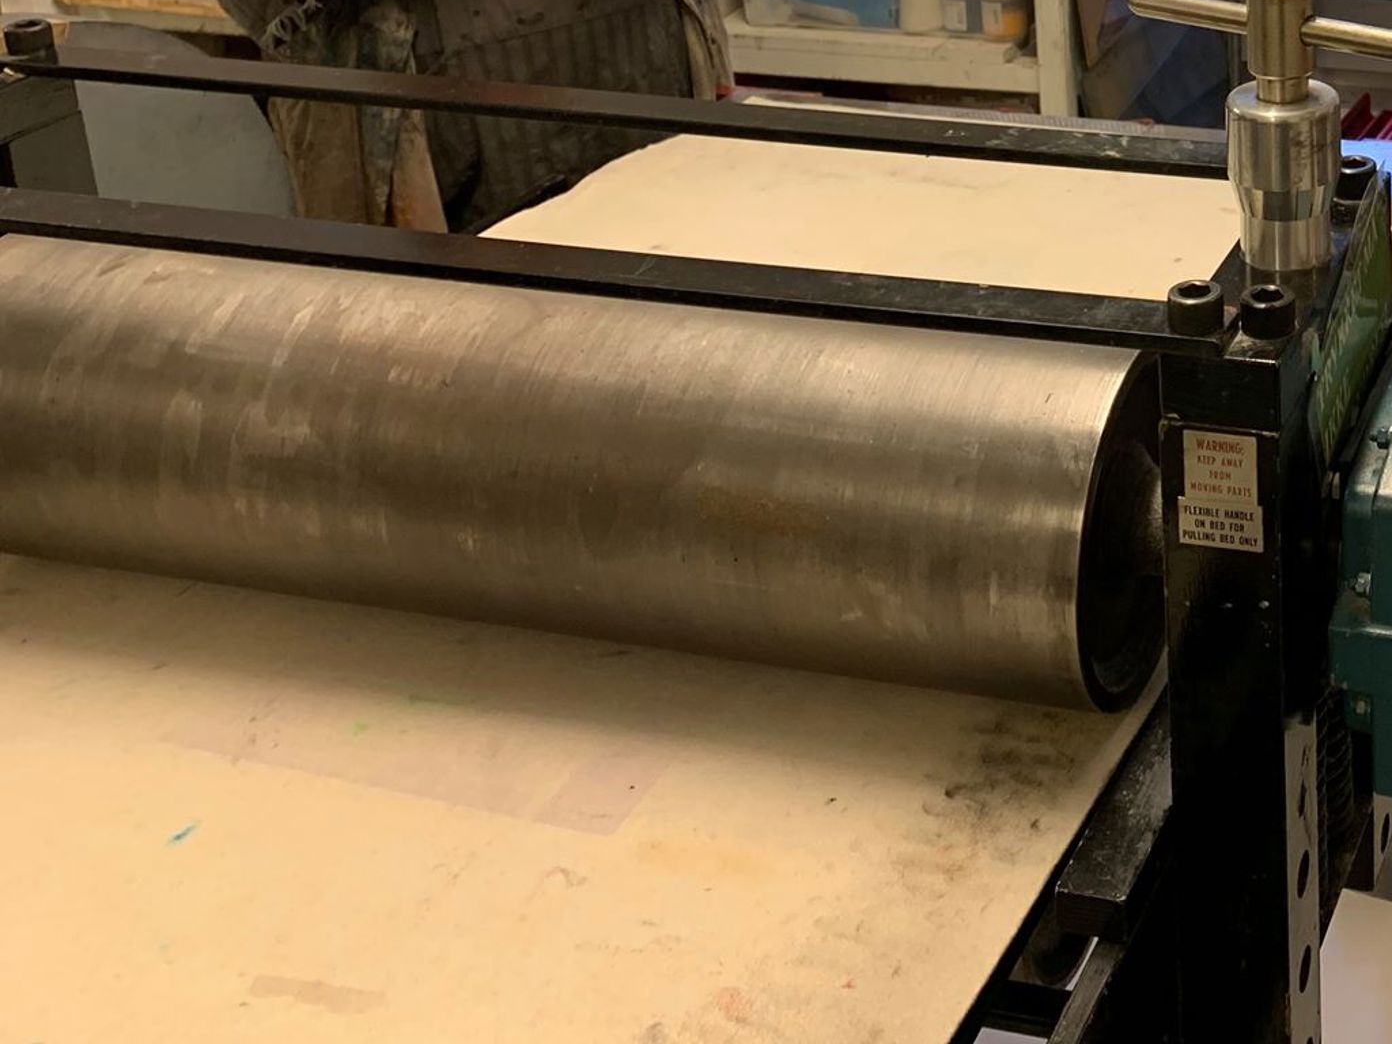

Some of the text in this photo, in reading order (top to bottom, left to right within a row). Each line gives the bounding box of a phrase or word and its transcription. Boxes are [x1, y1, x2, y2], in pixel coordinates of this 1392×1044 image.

[1197, 455, 1244, 469] KEEP AWAY
[1184, 505, 1255, 522] FLEXIBLE HANDLE
[1194, 519, 1245, 533] ON BED FOR
[1182, 529, 1258, 547] PULLING BED ONLY
